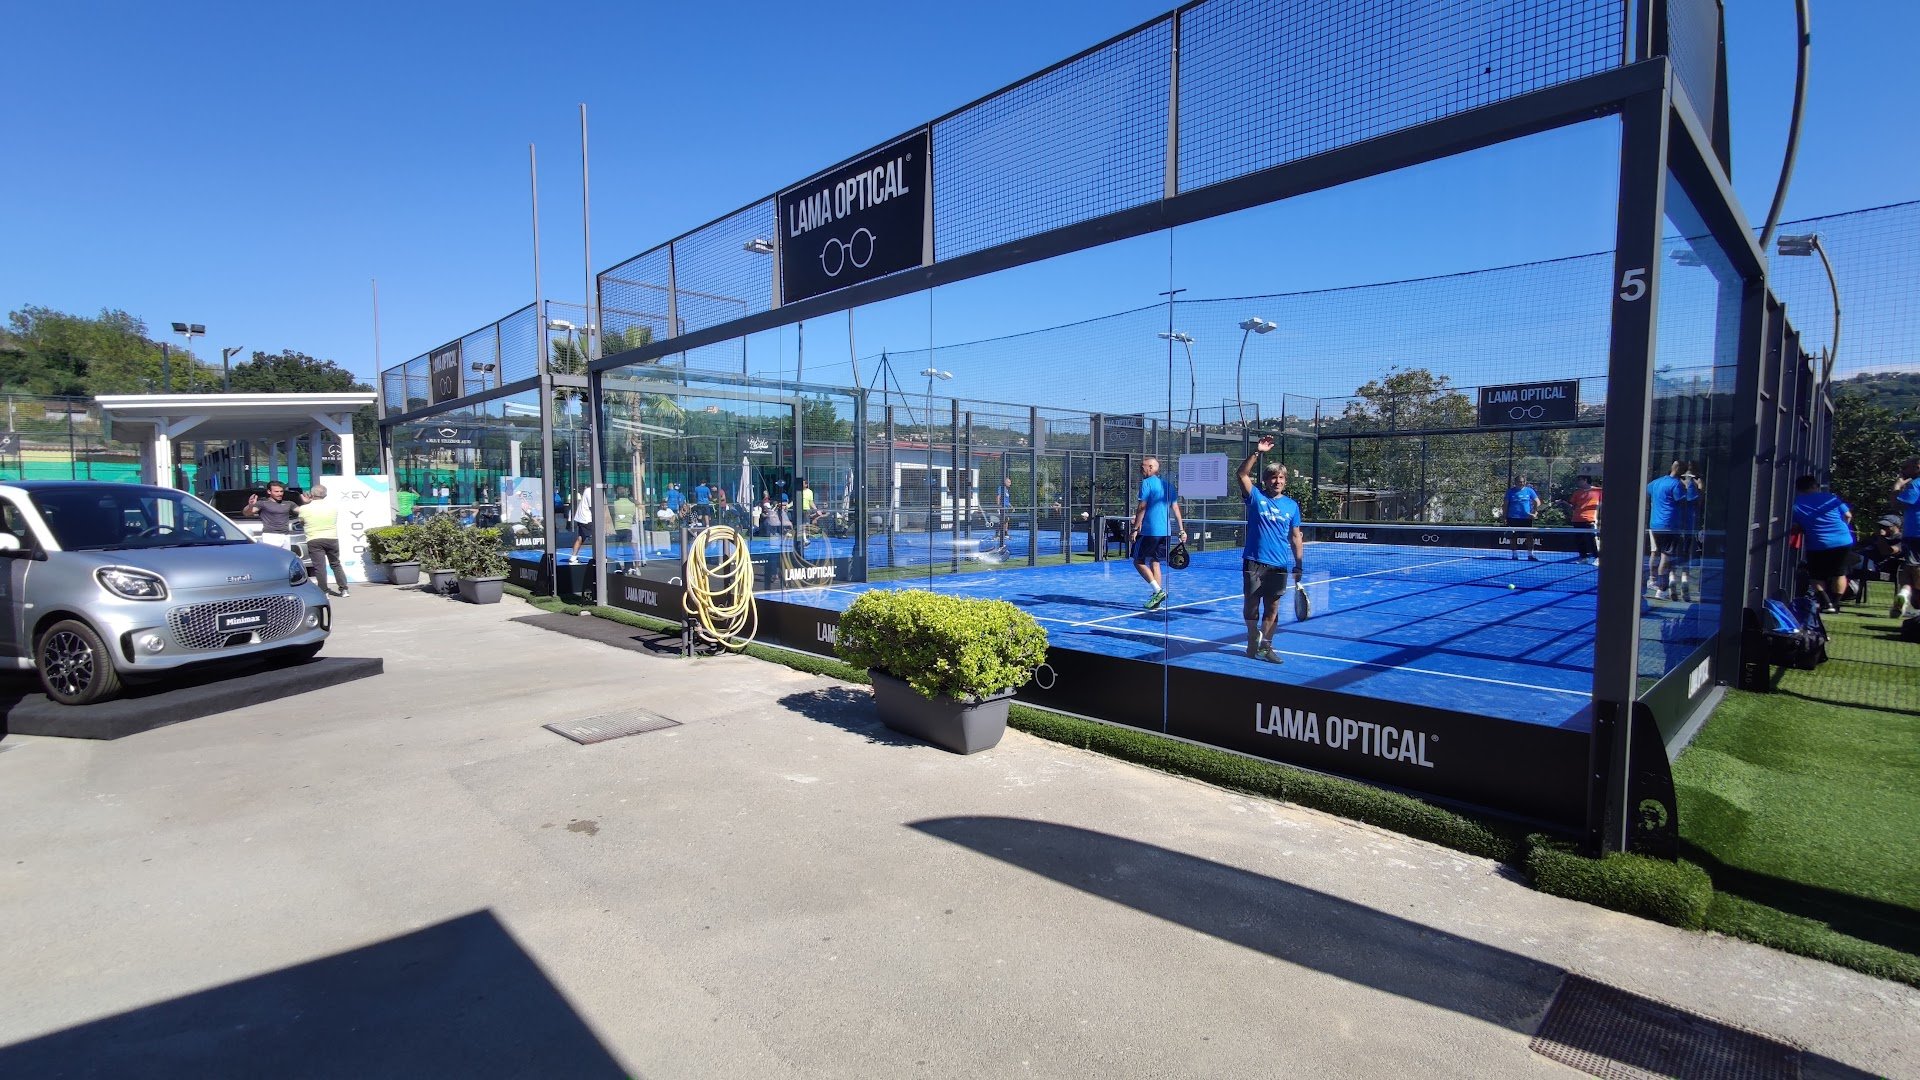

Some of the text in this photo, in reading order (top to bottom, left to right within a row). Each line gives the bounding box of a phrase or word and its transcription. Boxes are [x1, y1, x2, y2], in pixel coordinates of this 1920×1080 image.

[790, 188, 832, 238] LAMA
[1620, 267, 1646, 302] 5
[1488, 390, 1518, 404] LAMA
[341, 490, 370, 499] XEV
[515, 538, 532, 546] LAMA
[785, 568, 807, 581] LAMA
[624, 586, 639, 602] LAMA
[226, 615, 261, 626] Minimax
[817, 621, 838, 644] LAM
[1255, 702, 1320, 745] LAMA
